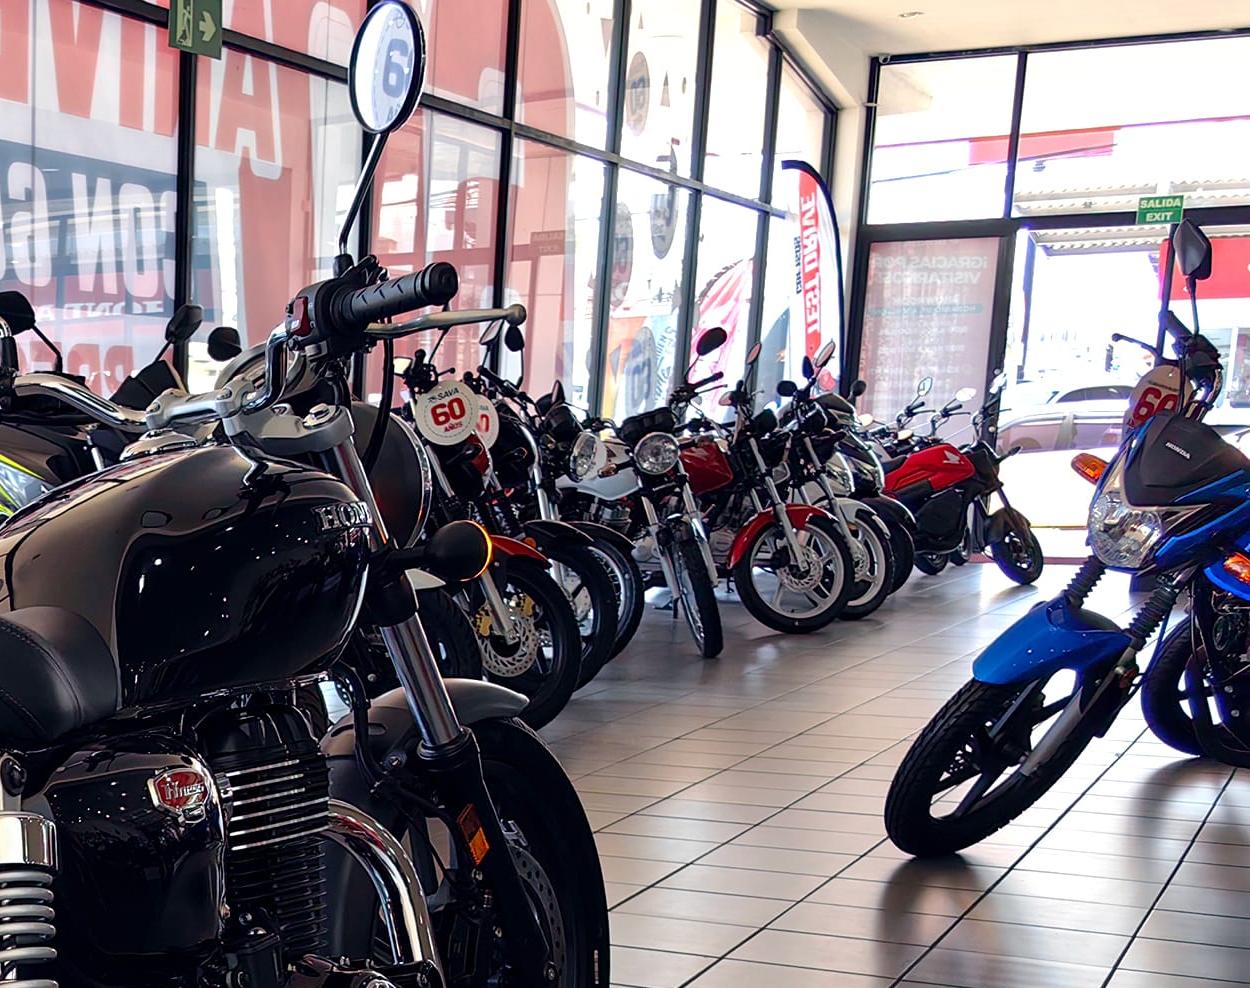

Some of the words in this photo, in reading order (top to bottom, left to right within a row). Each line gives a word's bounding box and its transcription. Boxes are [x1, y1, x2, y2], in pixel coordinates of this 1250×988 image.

[1140, 198, 1181, 209] SALIDA
[1146, 212, 1173, 222] EXIT
[438, 387, 460, 400] SAVA
[431, 397, 466, 426] 60
[1165, 441, 1191, 460] HONDA
